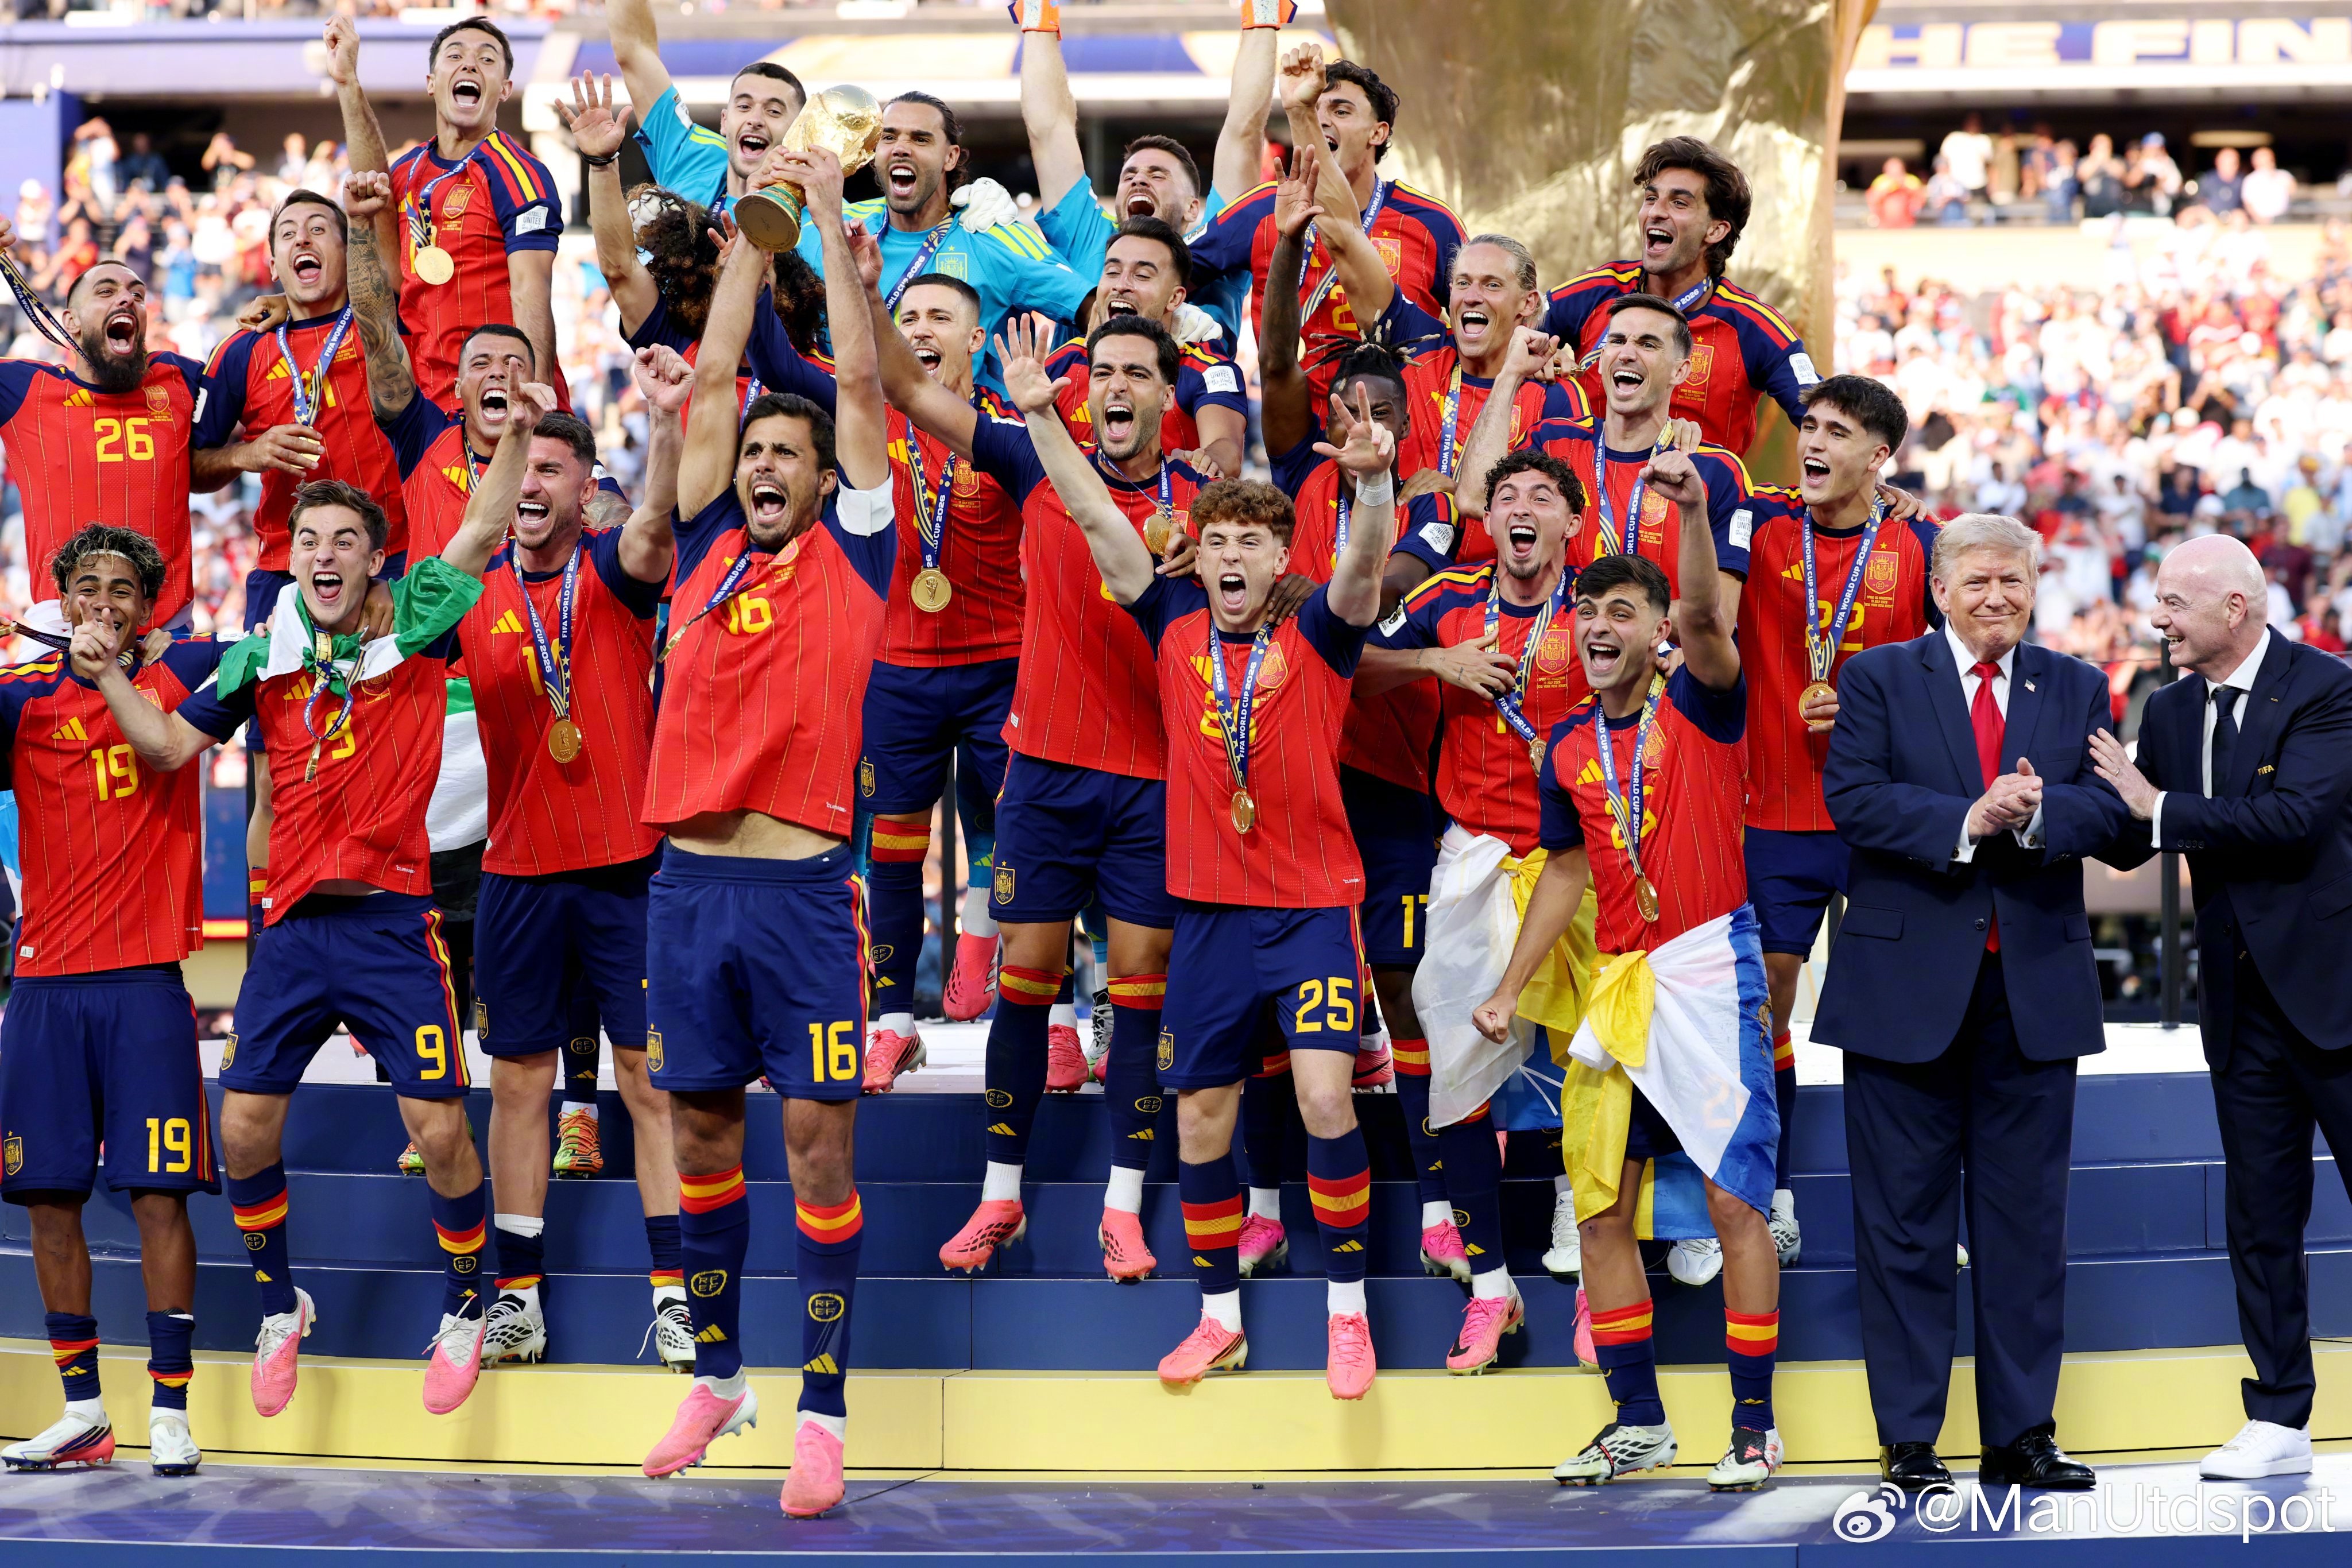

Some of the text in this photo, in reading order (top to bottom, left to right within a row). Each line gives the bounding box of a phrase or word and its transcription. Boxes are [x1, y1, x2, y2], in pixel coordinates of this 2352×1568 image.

[453, 162, 464, 173] CUP
[712, 201, 722, 212] FIFA
[1371, 192, 1381, 217] WORLD
[523, 216, 541, 225] UNITES
[886, 290, 900, 310] ORLD
[907, 255, 926, 280] 2026
[1680, 288, 1699, 305] 2026
[13, 285, 46, 334] FIFA WORLD CUP
[324, 344, 335, 358] FIFA
[332, 320, 347, 345] WORLD
[343, 307, 353, 322] CUP
[278, 340, 292, 363] WORLD
[94, 417, 156, 462] 26
[1441, 434, 1452, 474] FIFA WORL
[1631, 486, 1641, 514] 2026
[933, 522, 941, 539] CUP
[937, 494, 946, 522] 2026
[1438, 522, 1451, 539] OOTBALL
[1737, 521, 1751, 532] UNITE
[1433, 524, 1449, 544] UNITES
[564, 572, 572, 589] CUP
[711, 589, 725, 603] FIFA
[720, 570, 739, 590] WORLD
[736, 558, 748, 571] CUP
[1557, 573, 1566, 597] 2026
[1835, 538, 1871, 628] FIFA WORLD CUP 2026
[563, 590, 571, 619] WORLD
[725, 583, 772, 635] 16
[528, 599, 552, 673] WORLD CUP 2026
[1211, 646, 1219, 663] CUP
[1214, 663, 1224, 692] 2026
[1245, 661, 1257, 691] 2026
[336, 700, 351, 727] 2026
[1498, 697, 1531, 735] FIFA WORLD
[325, 710, 355, 760] 9
[91, 743, 138, 801] 19
[1603, 752, 1614, 781] 2026
[2257, 765, 2274, 776] FIFA
[1295, 977, 1354, 1033] 25
[415, 1024, 446, 1080] 9
[808, 1020, 857, 1082] 16
[146, 1118, 191, 1172] 19
[815, 1307, 835, 1315] EF
